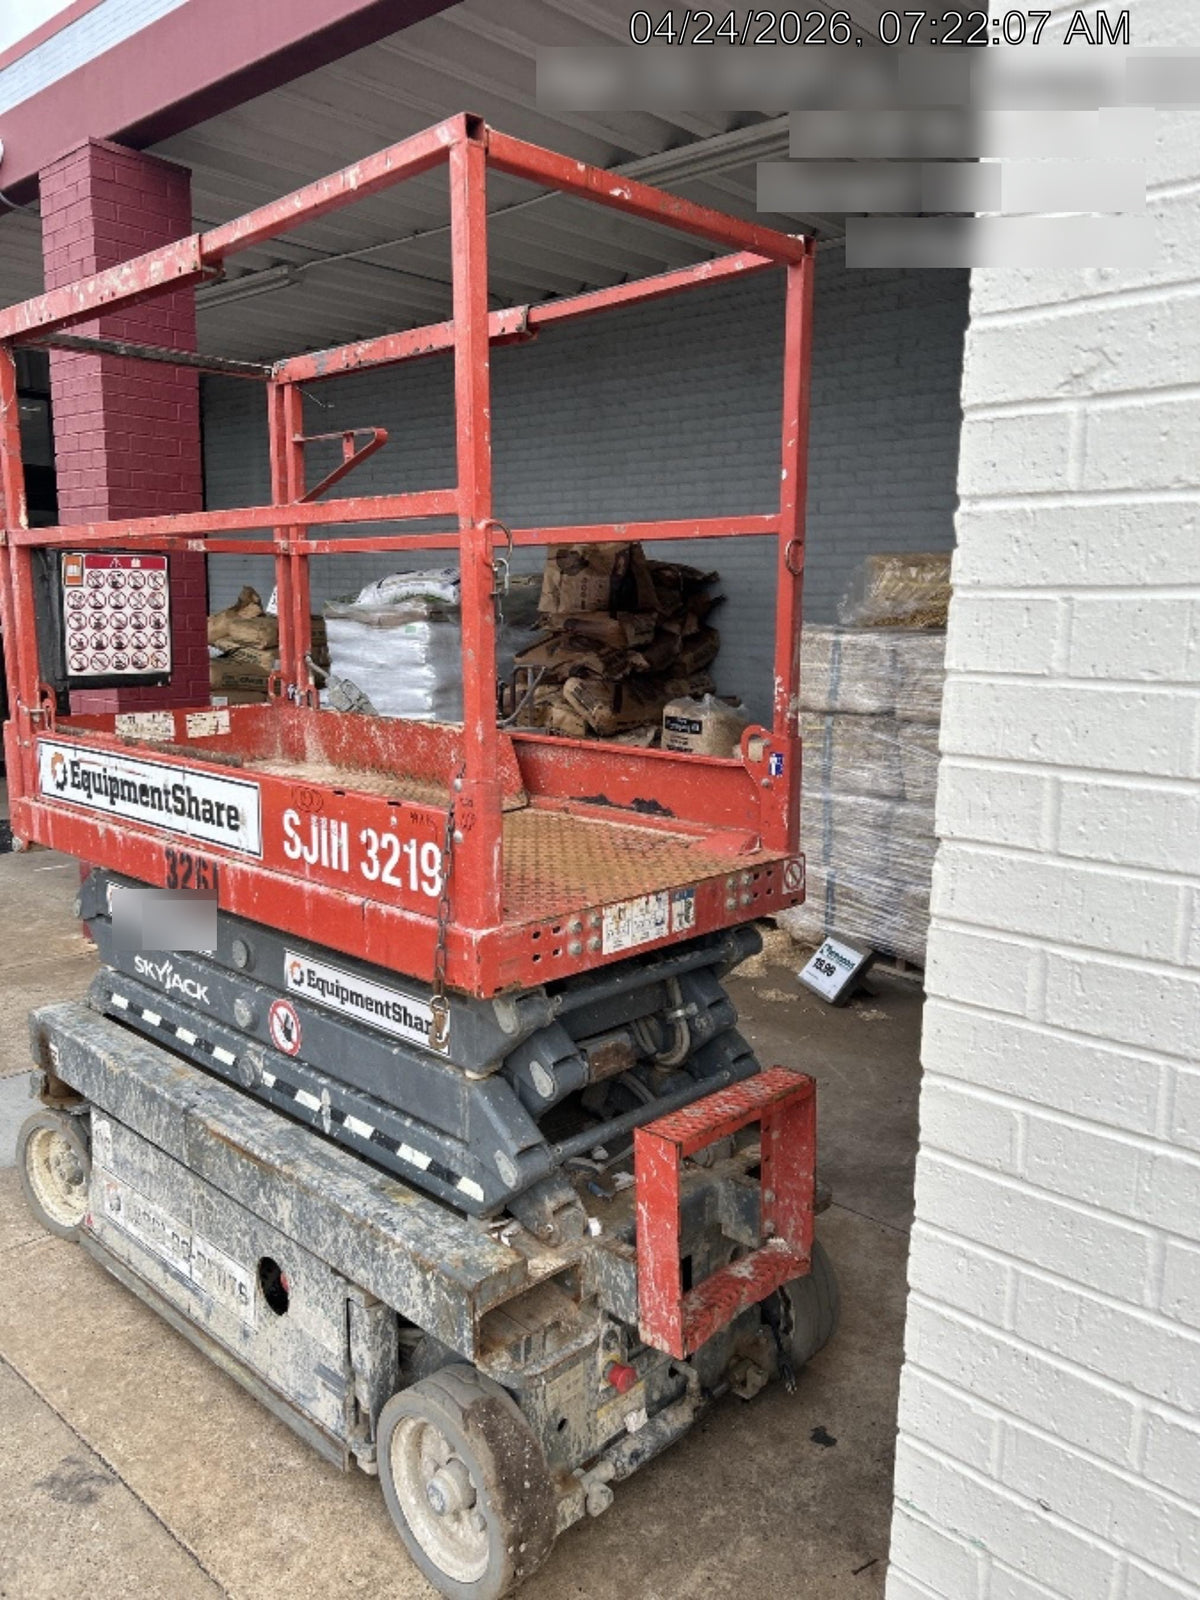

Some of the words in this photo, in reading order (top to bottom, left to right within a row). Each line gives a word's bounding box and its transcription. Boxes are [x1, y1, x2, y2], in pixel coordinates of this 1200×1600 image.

[70, 759, 240, 831] EquipmentShare
[360, 827, 443, 897] 3219
[134, 955, 210, 1005] SKYJACK
[307, 968, 442, 1039] EquipmentShar
